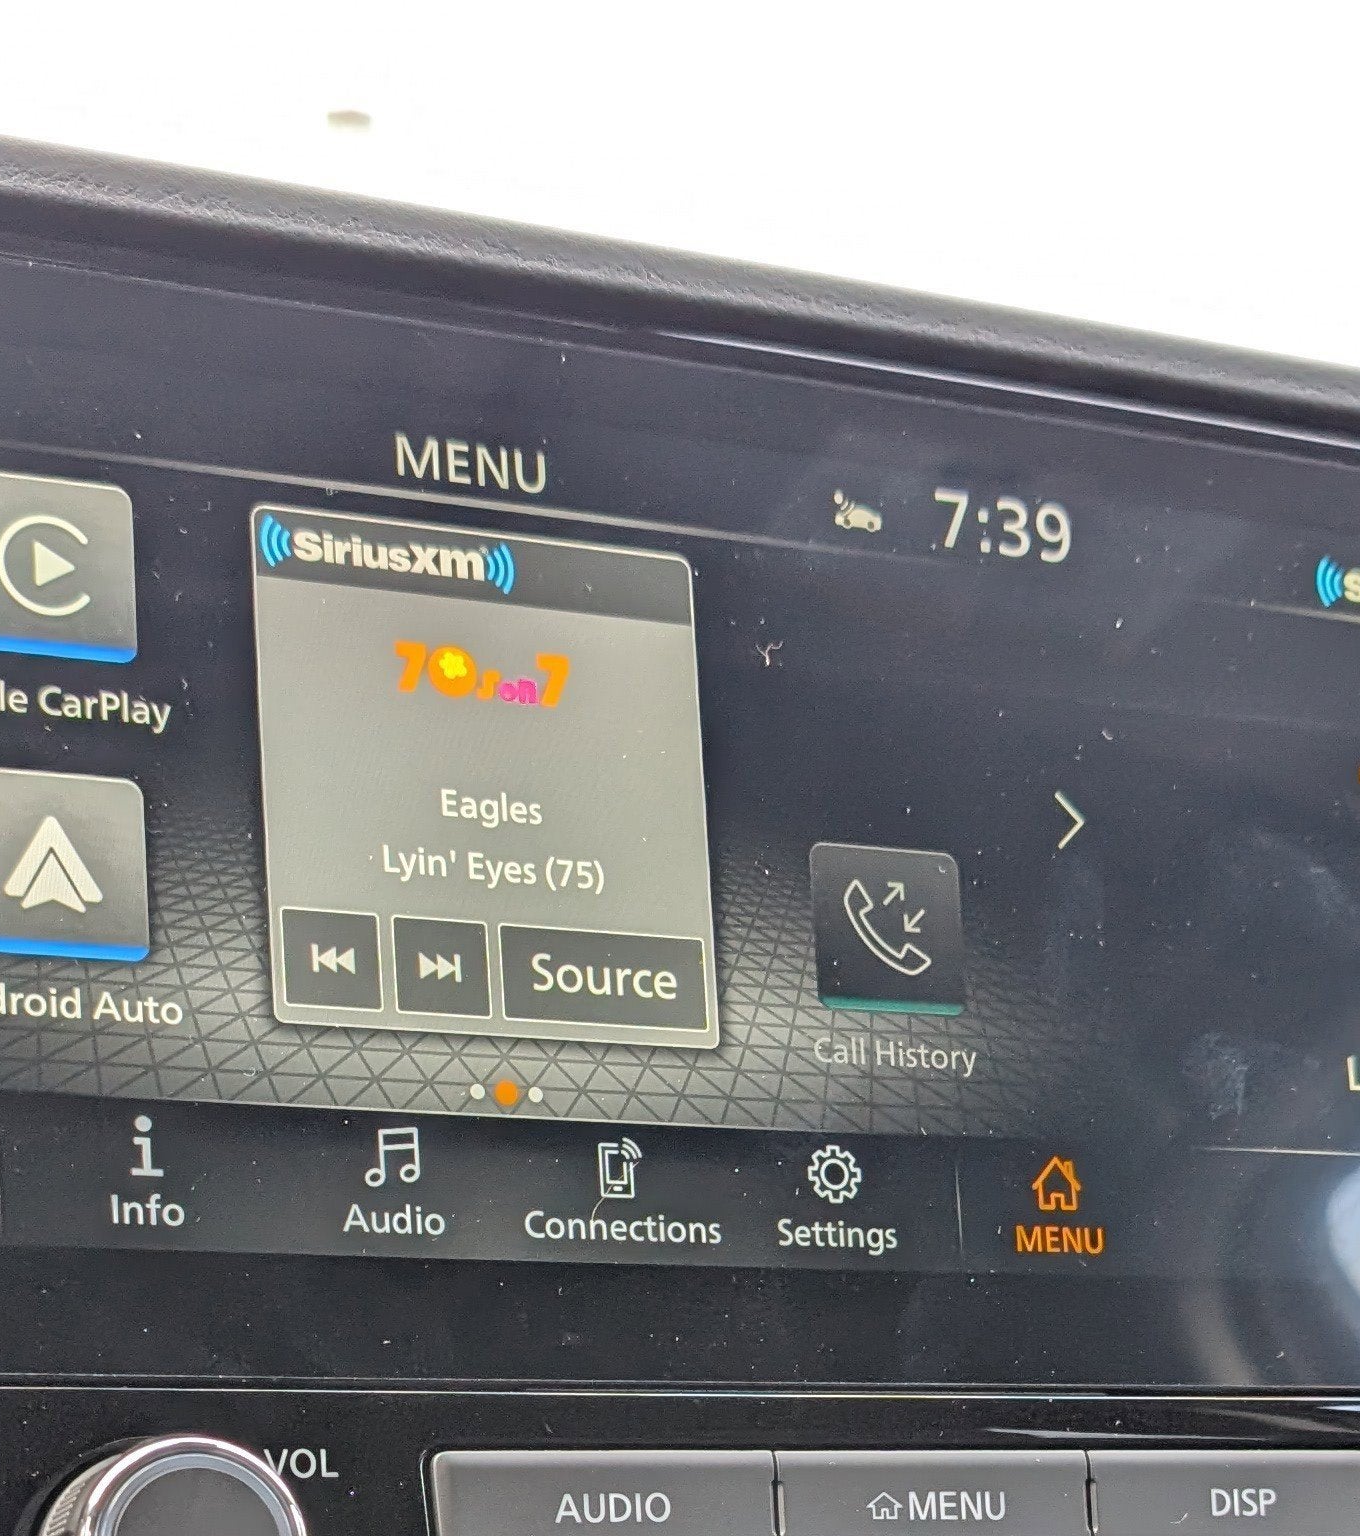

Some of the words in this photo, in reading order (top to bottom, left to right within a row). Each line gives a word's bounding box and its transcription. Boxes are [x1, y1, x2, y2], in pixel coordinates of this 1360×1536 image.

[394, 434, 547, 494] MENU
[934, 489, 1071, 563] 7:39
[39, 684, 171, 733] CarPlay
[441, 789, 542, 828] Eagles
[382, 843, 458, 883] Lyin'
[468, 853, 537, 889] Eyes
[546, 856, 605, 894] (75)
[532, 953, 677, 1001] Source
[94, 992, 183, 1025] Auto
[814, 1037, 868, 1066] Call
[875, 1042, 976, 1078] History
[111, 1194, 186, 1227] Info
[343, 1203, 445, 1238] Audio
[524, 1211, 721, 1245] Connections
[778, 1219, 898, 1254] Settings
[1015, 1225, 1104, 1254] MENU
[263, 1448, 338, 1478] VOL
[555, 1493, 670, 1524] AUDIO
[908, 1490, 1007, 1521] MENU
[1210, 1488, 1278, 1518] DISP
